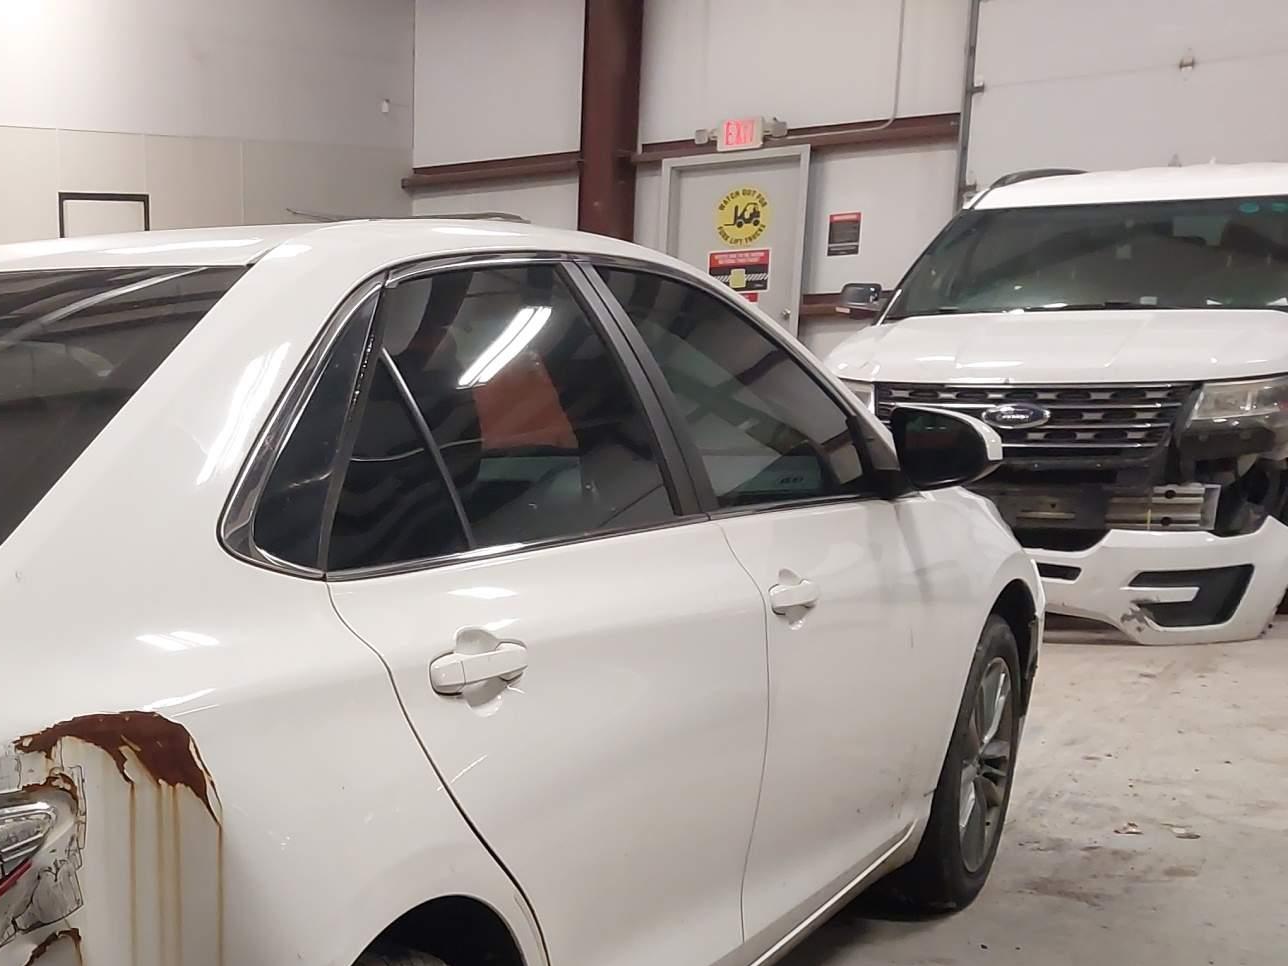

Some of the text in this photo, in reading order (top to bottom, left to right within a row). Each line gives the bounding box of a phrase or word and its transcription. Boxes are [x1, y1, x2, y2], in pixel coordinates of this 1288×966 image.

[724, 120, 754, 145] EXIT
[718, 188, 768, 211] WATCH OUT FOR
[717, 224, 766, 246] FORK LIFT TRUCKS
